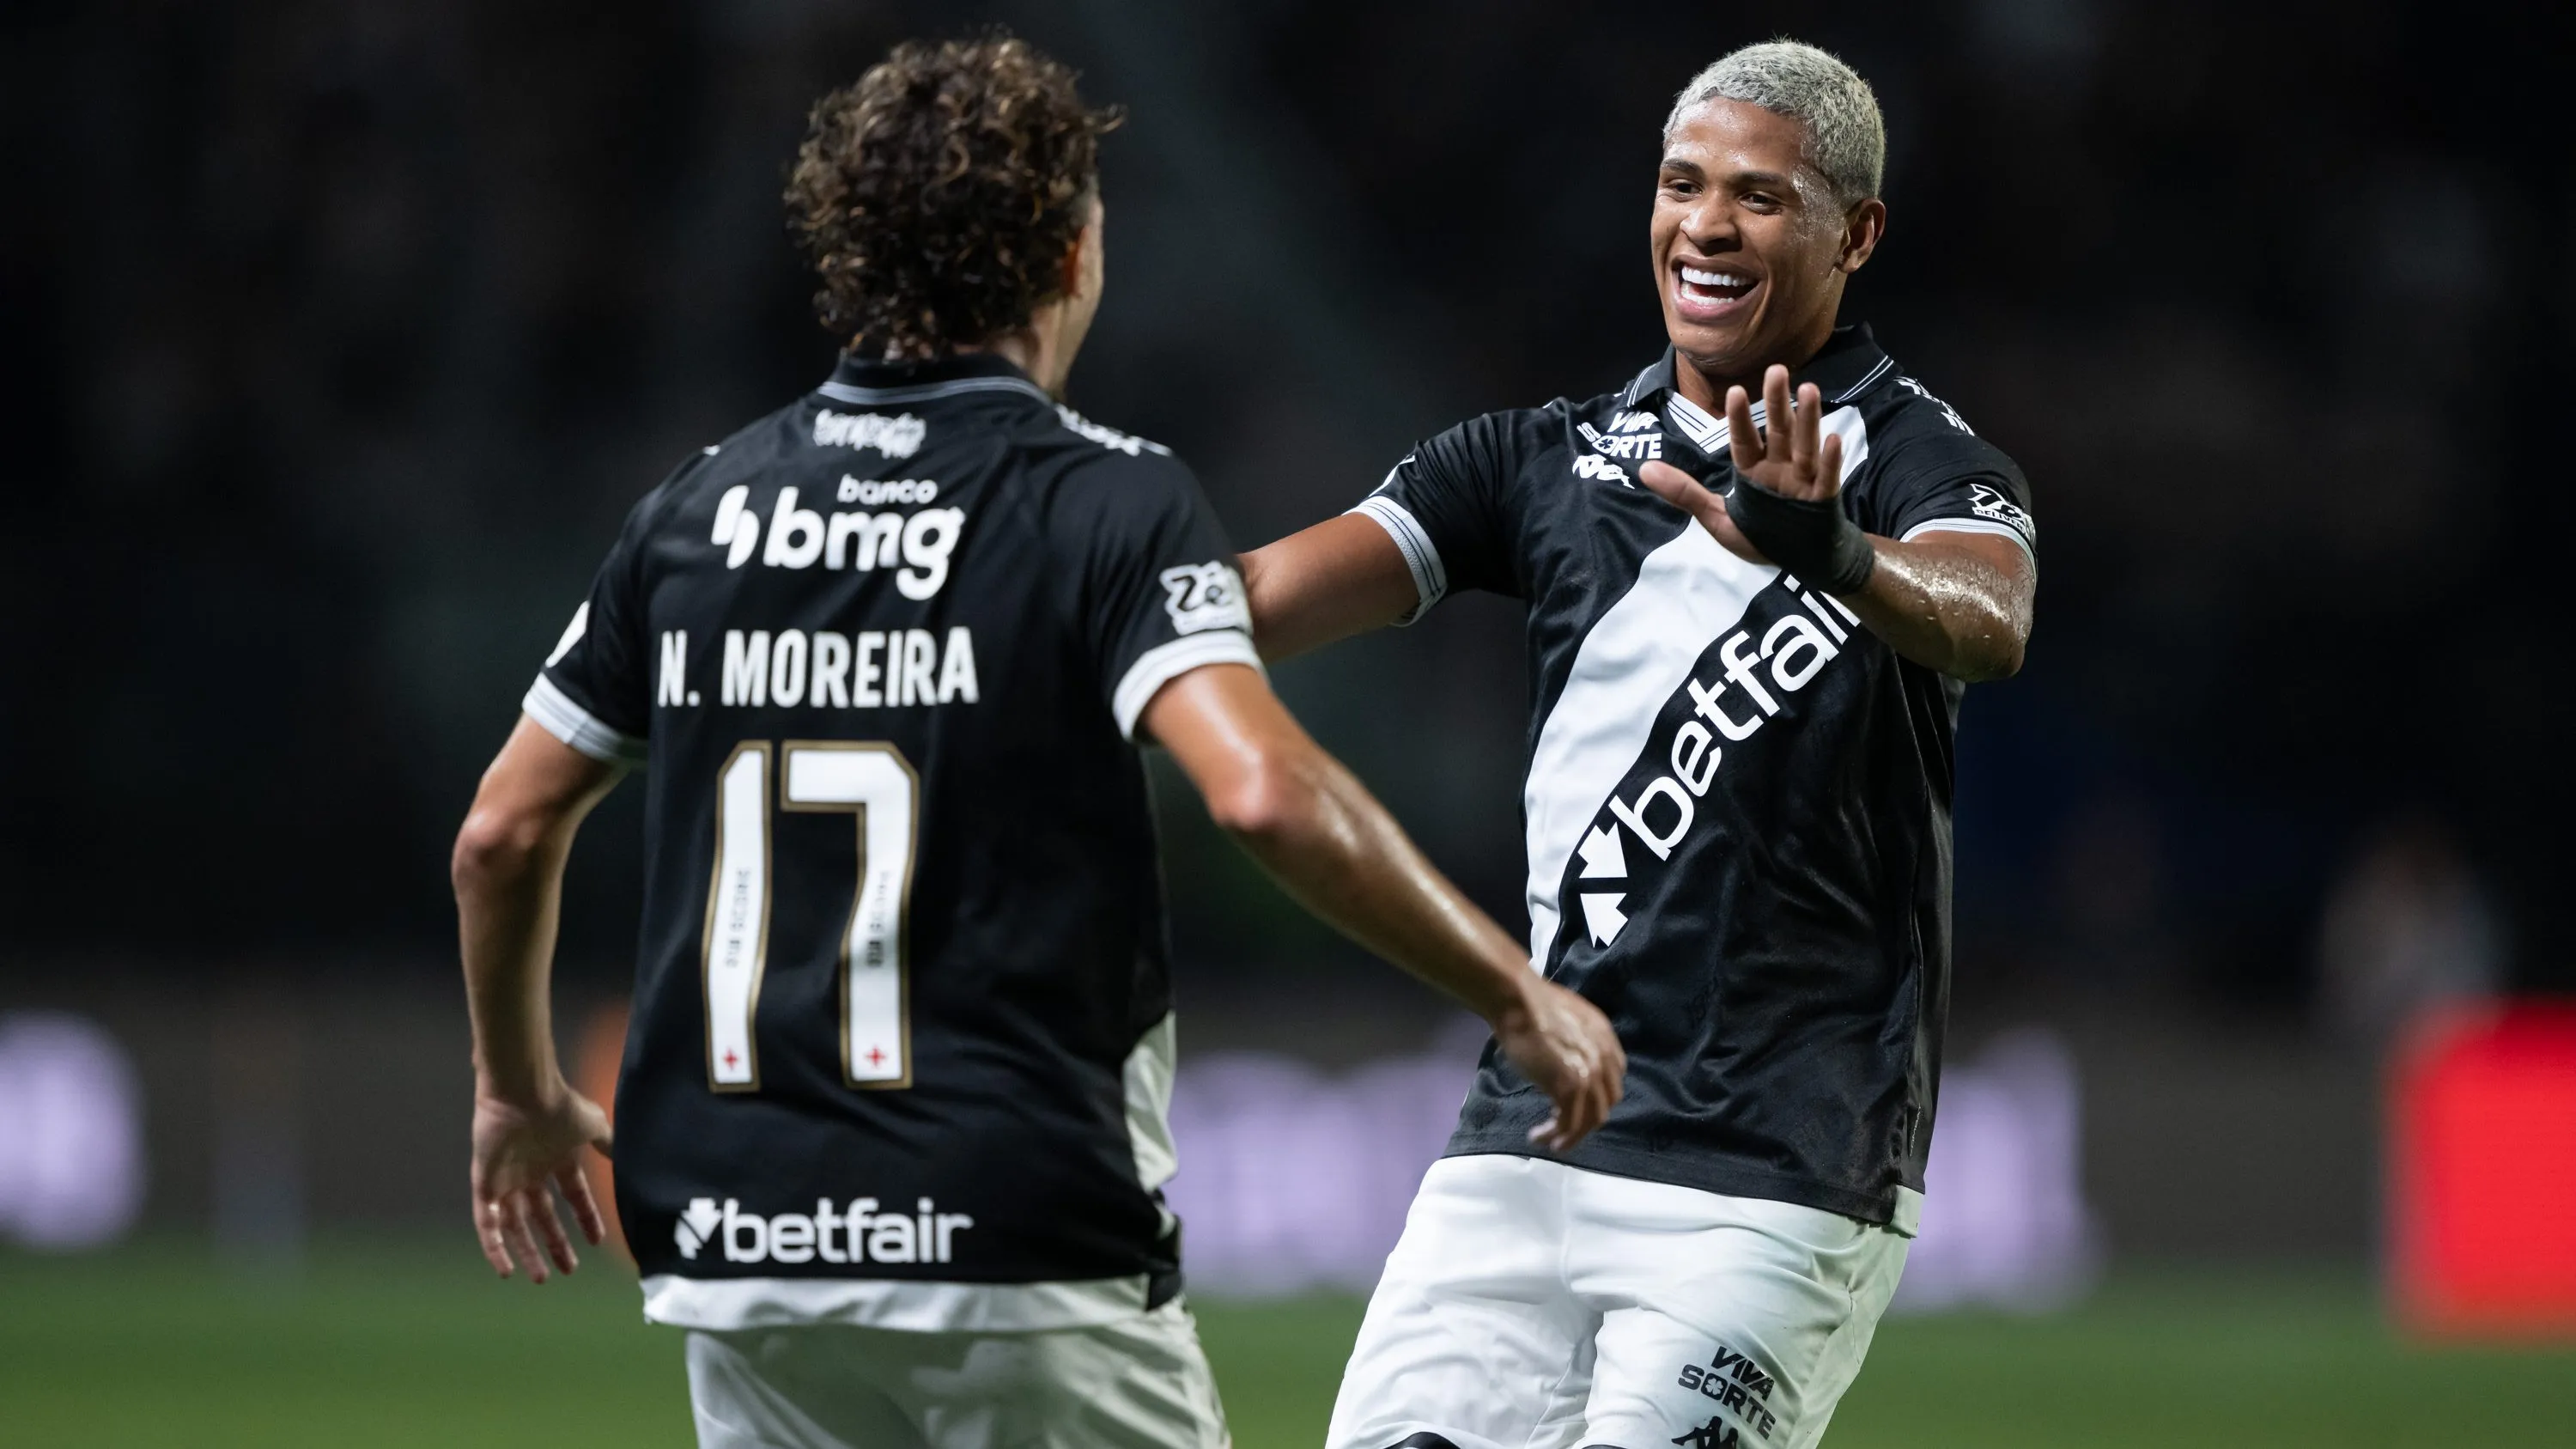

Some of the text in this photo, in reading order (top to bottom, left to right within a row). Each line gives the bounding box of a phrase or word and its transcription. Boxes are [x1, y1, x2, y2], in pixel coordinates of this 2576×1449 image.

[836, 473, 939, 505] banco
[1976, 508, 2026, 530] DELIVER
[762, 485, 966, 601] bmg
[657, 626, 979, 709] N. MOREIRA
[701, 740, 920, 1093] 17
[722, 1197, 974, 1263] betfair
[1678, 1363, 1777, 1440] SORTE
[1710, 1345, 1775, 1402] VIVA
